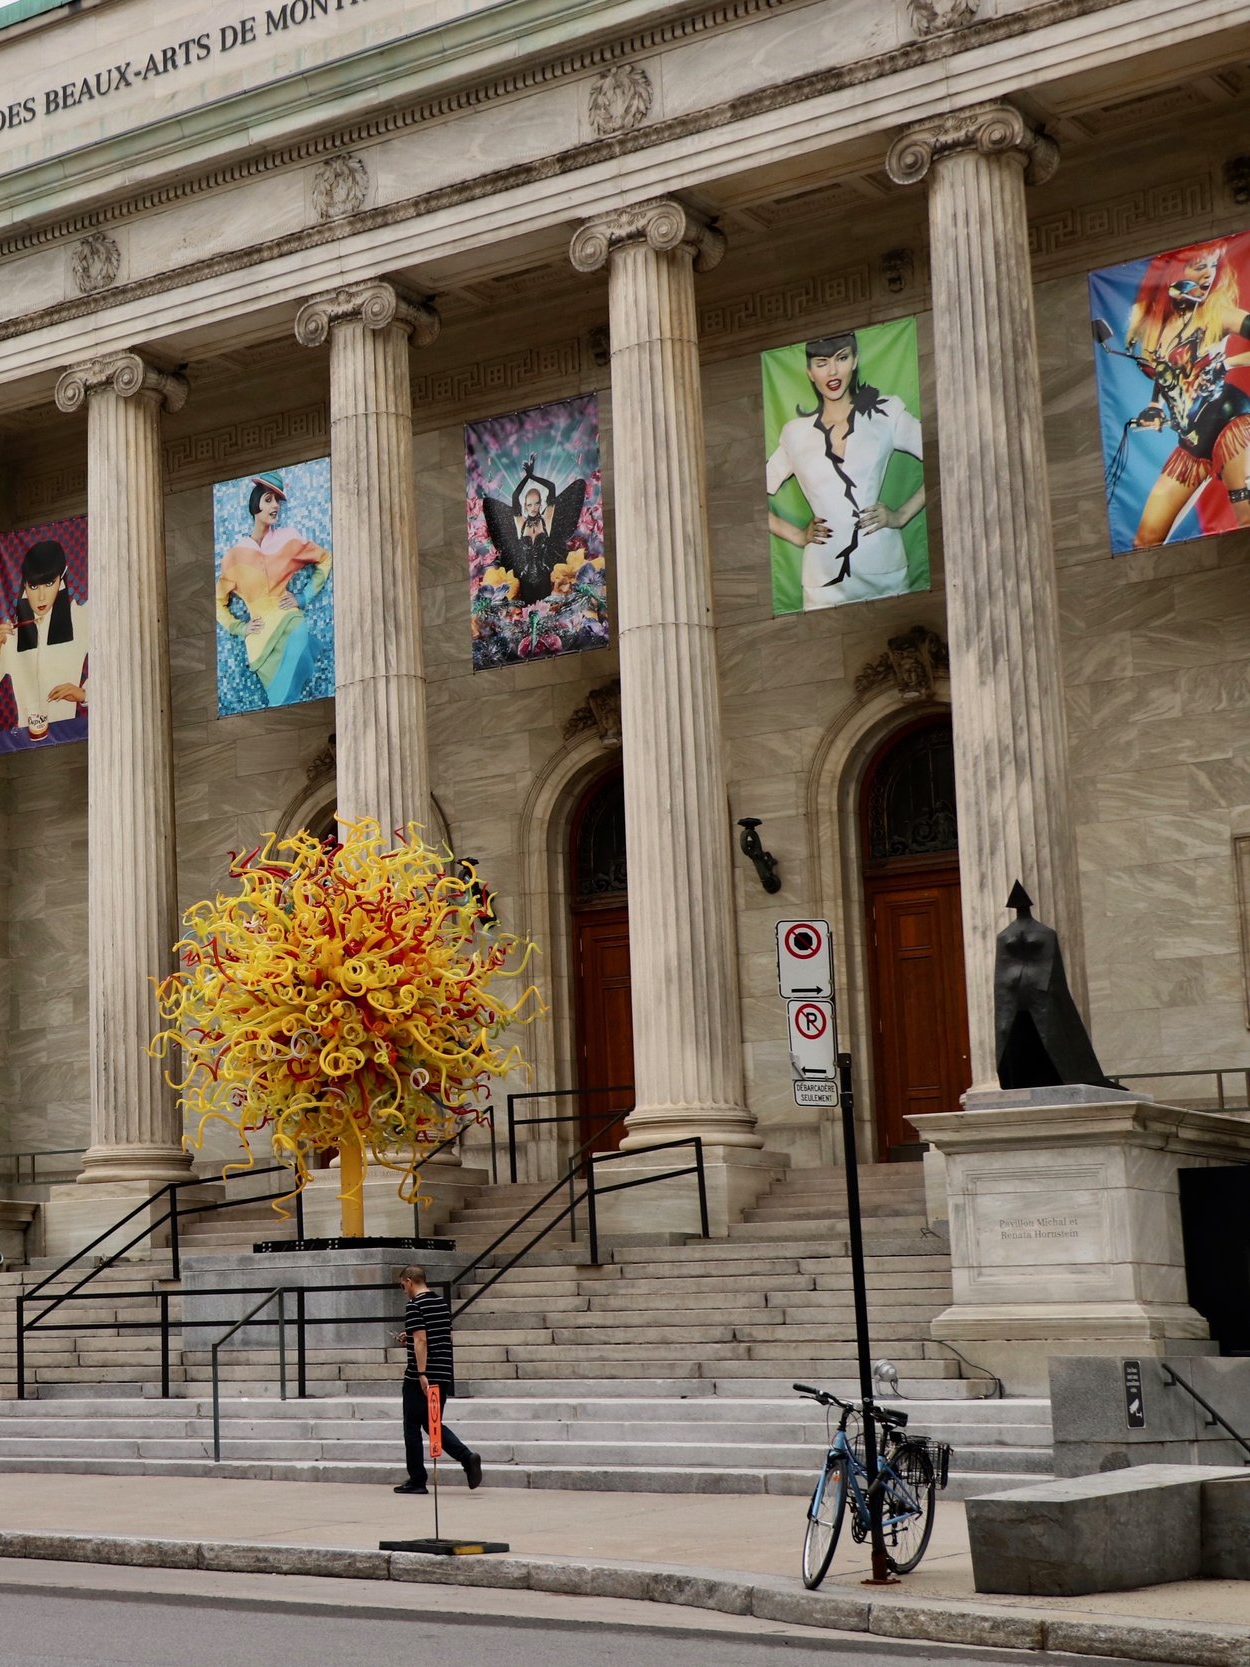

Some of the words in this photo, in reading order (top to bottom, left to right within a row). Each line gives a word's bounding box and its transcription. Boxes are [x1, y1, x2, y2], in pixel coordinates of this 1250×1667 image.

[43, 33, 211, 115] BEAUX-ARTS
[219, 16, 256, 53] DE
[800, 1093, 832, 1102] SEULEMENT
[999, 1218, 1035, 1228] Pavillon
[1069, 1218, 1078, 1226] et
[1001, 1231, 1032, 1240] Renata
[1034, 1230, 1079, 1239] Hornstein
